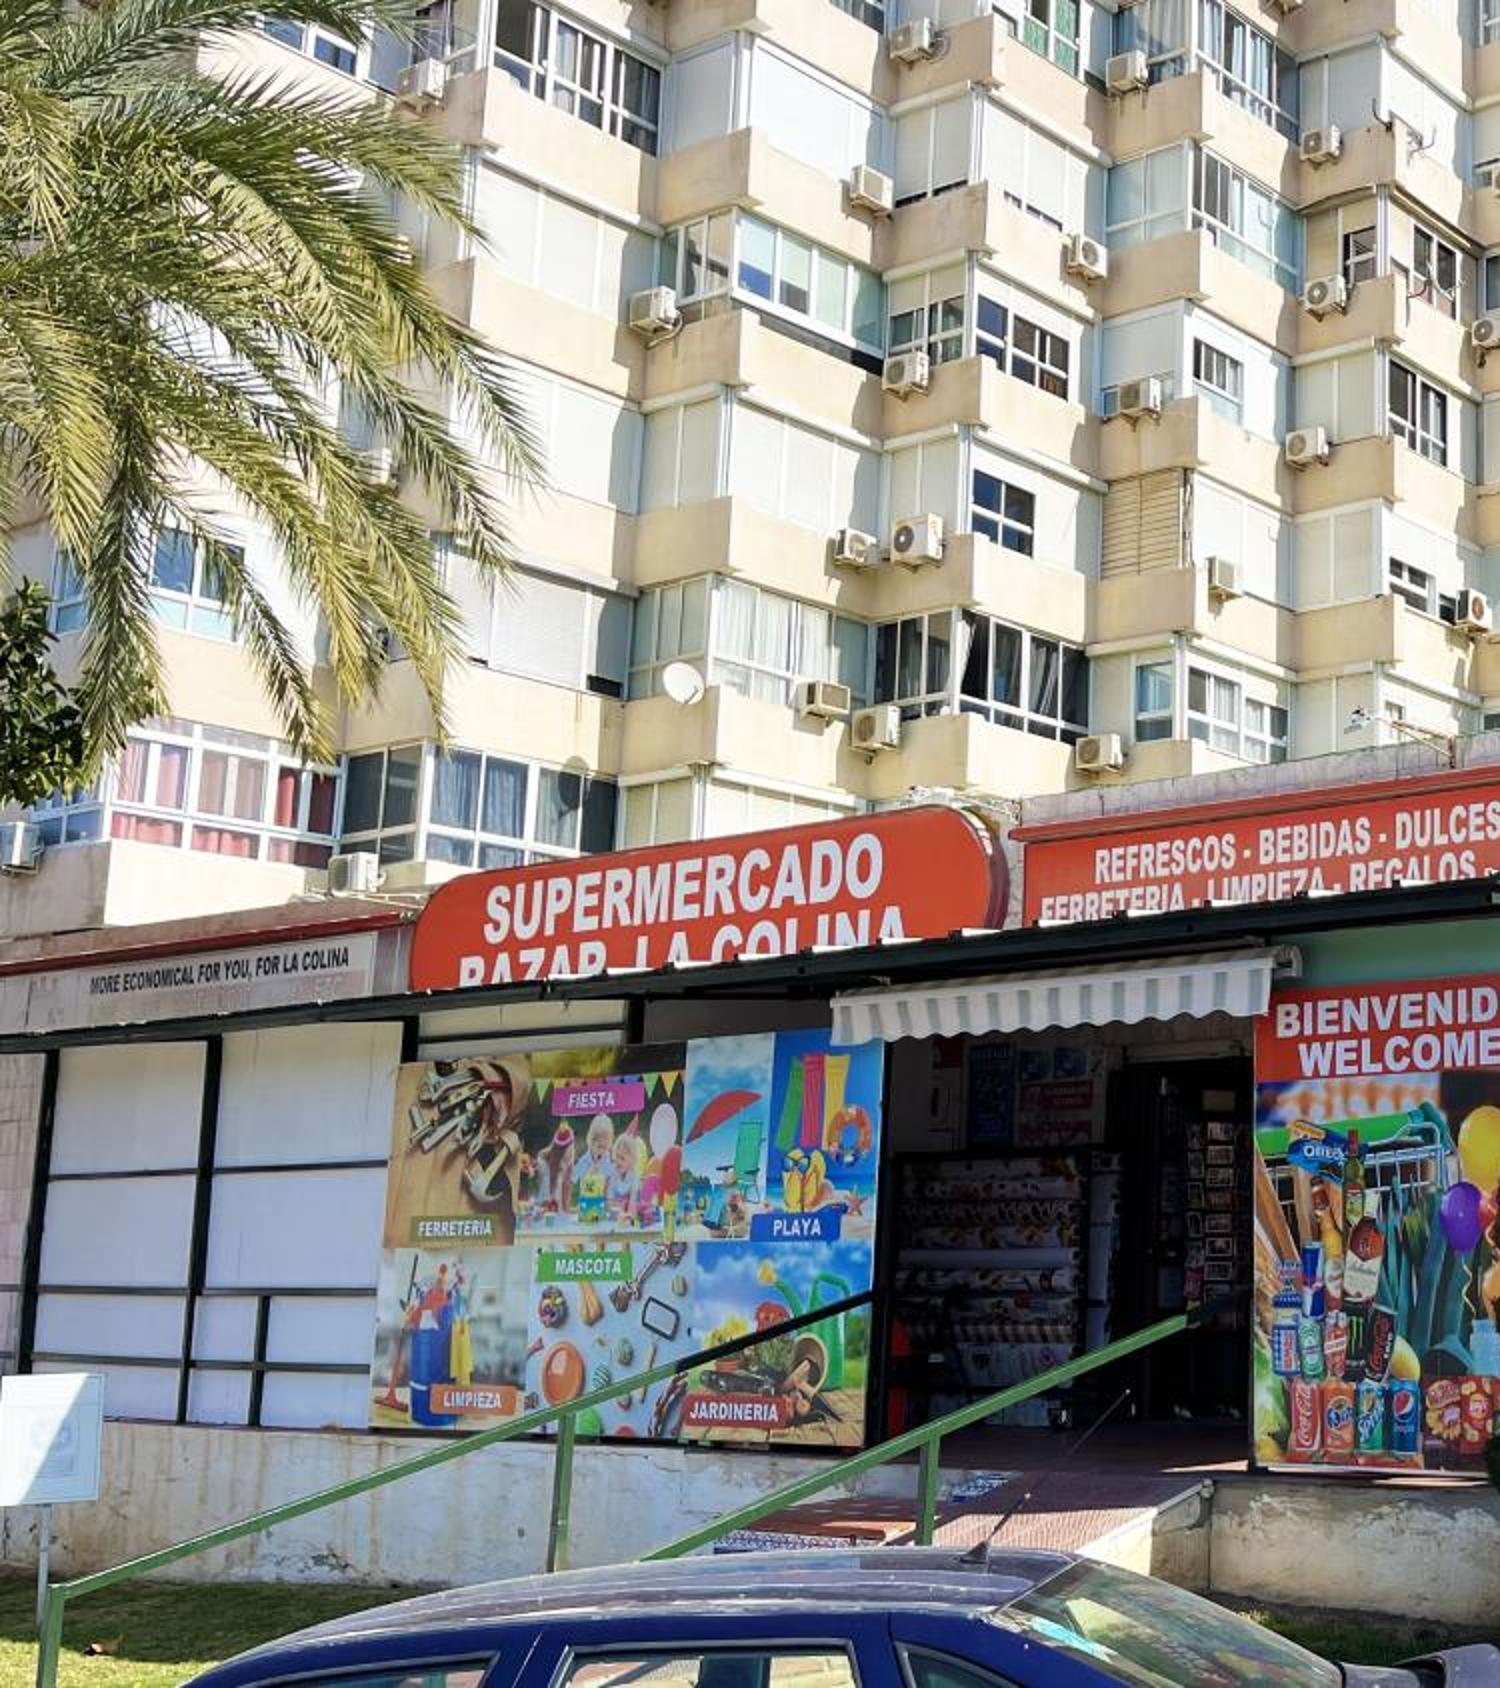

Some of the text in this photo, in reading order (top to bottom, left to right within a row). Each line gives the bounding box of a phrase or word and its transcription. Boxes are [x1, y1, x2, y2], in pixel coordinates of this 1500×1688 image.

[1094, 833, 1236, 884] REFRESCOS
[1259, 818, 1371, 865] BEBIDAS
[483, 833, 884, 944] SUPERMERCADO
[1041, 883, 1185, 920] FERRETERIA
[1207, 868, 1323, 903] LIMPIEZA
[90, 947, 349, 995] MORE ECONOMICAL FOR YOU, FOR LA COLINA
[567, 1091, 615, 1109] FIESTA
[417, 1220, 492, 1237] FERRETERIA
[773, 1219, 822, 1237] PLAYA
[555, 1257, 621, 1275] MASCOTA
[443, 1392, 502, 1409] LIMPIEZA
[689, 1402, 778, 1422] JARDINERIA
